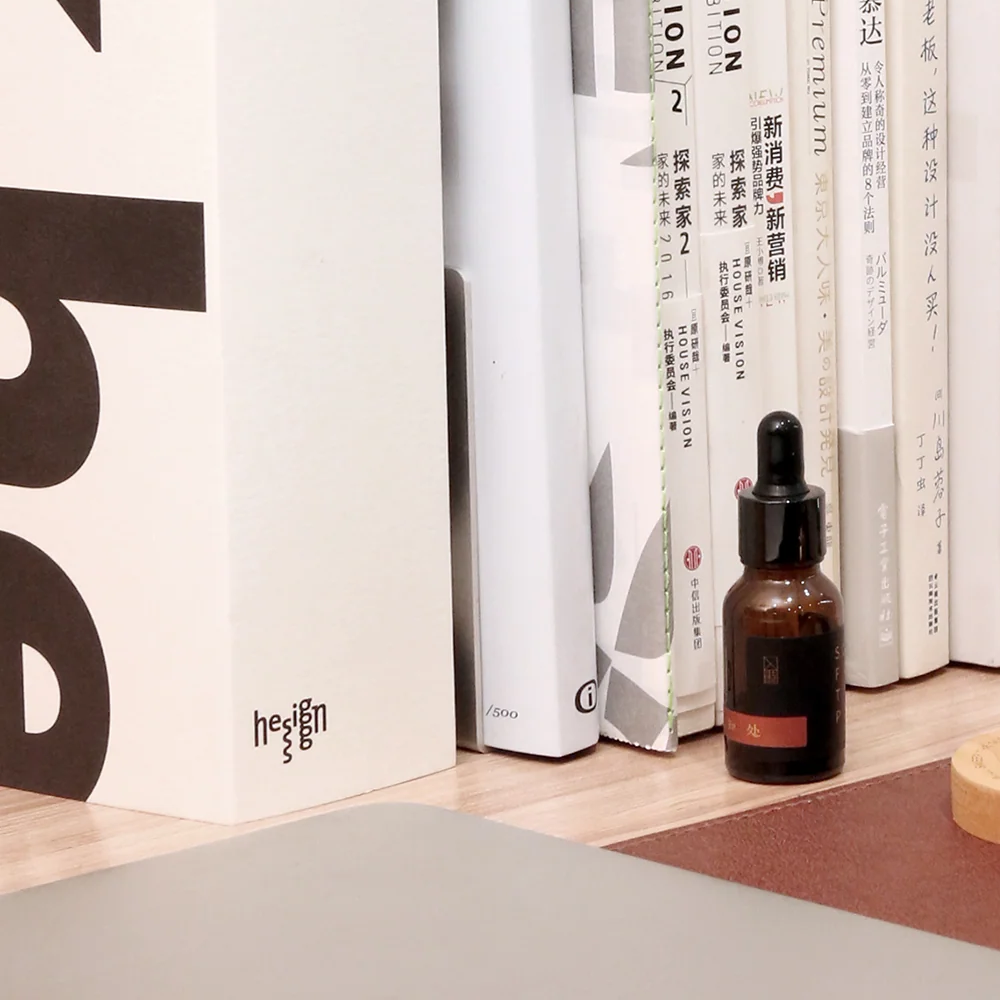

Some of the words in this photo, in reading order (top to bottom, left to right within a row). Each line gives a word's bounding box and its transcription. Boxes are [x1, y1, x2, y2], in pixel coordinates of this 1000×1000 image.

[874, 60, 887, 190] 令人称奇的设计经营
[711, 153, 729, 227] 家的未来
[729, 149, 748, 229] 探索家
[751, 116, 764, 216] 引爆强势品牌力
[732, 257, 743, 314] HOUSE
[876, 252, 889, 336] バルミューダ
[678, 325, 690, 382] HOUSE
[734, 319, 746, 381] VISION
[681, 387, 693, 449] VISION
[485, 704, 519, 720] /500
